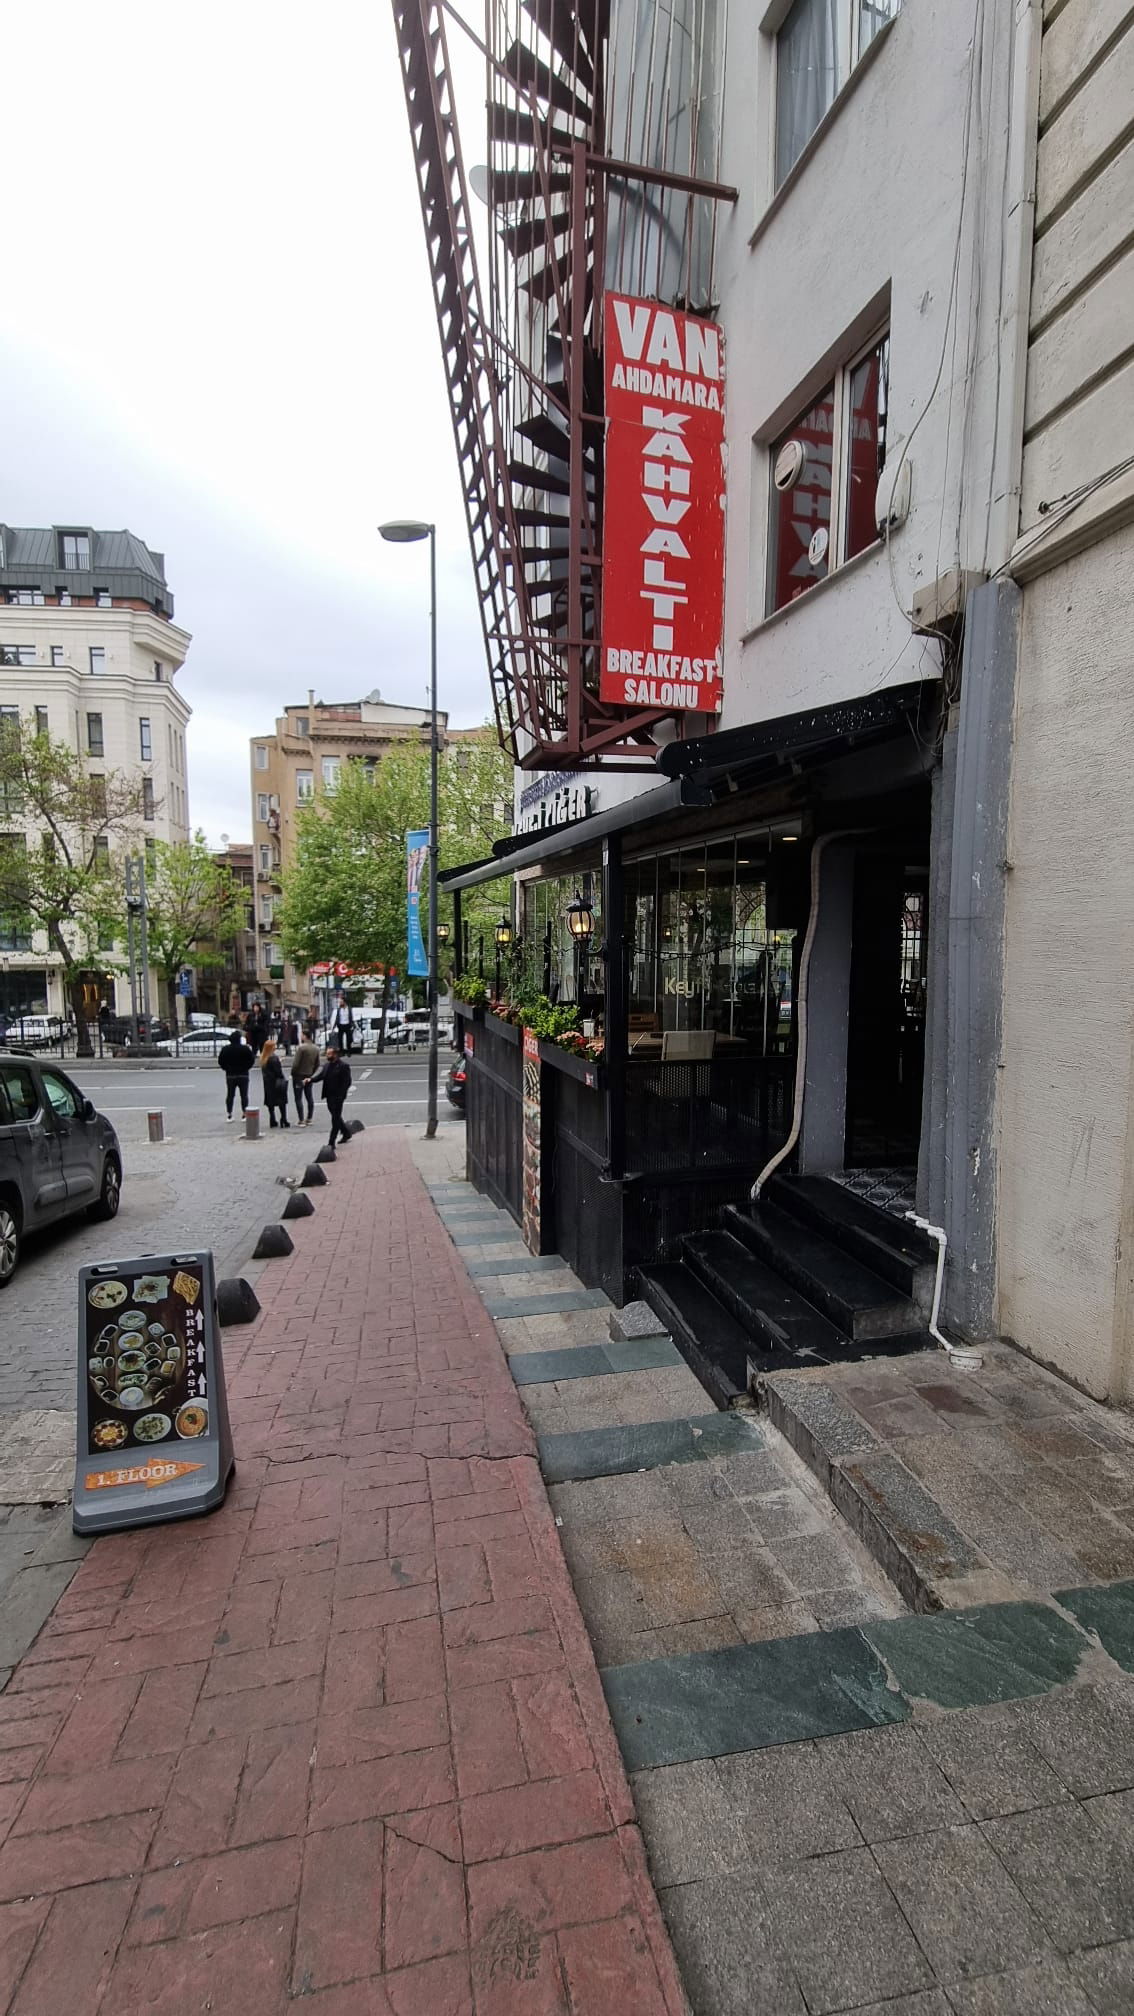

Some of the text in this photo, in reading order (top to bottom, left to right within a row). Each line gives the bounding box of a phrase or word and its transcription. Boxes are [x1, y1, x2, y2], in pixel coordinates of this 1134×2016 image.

[613, 300, 720, 381] VAN
[612, 363, 720, 412] AHDAMARA
[640, 406, 693, 651] KAHVALTI
[607, 648, 716, 683] BREAKFAST
[624, 678, 699, 709] SALONU
[184, 1309, 197, 1397] BREAKFAST
[117, 1463, 177, 1484] FLOOR
